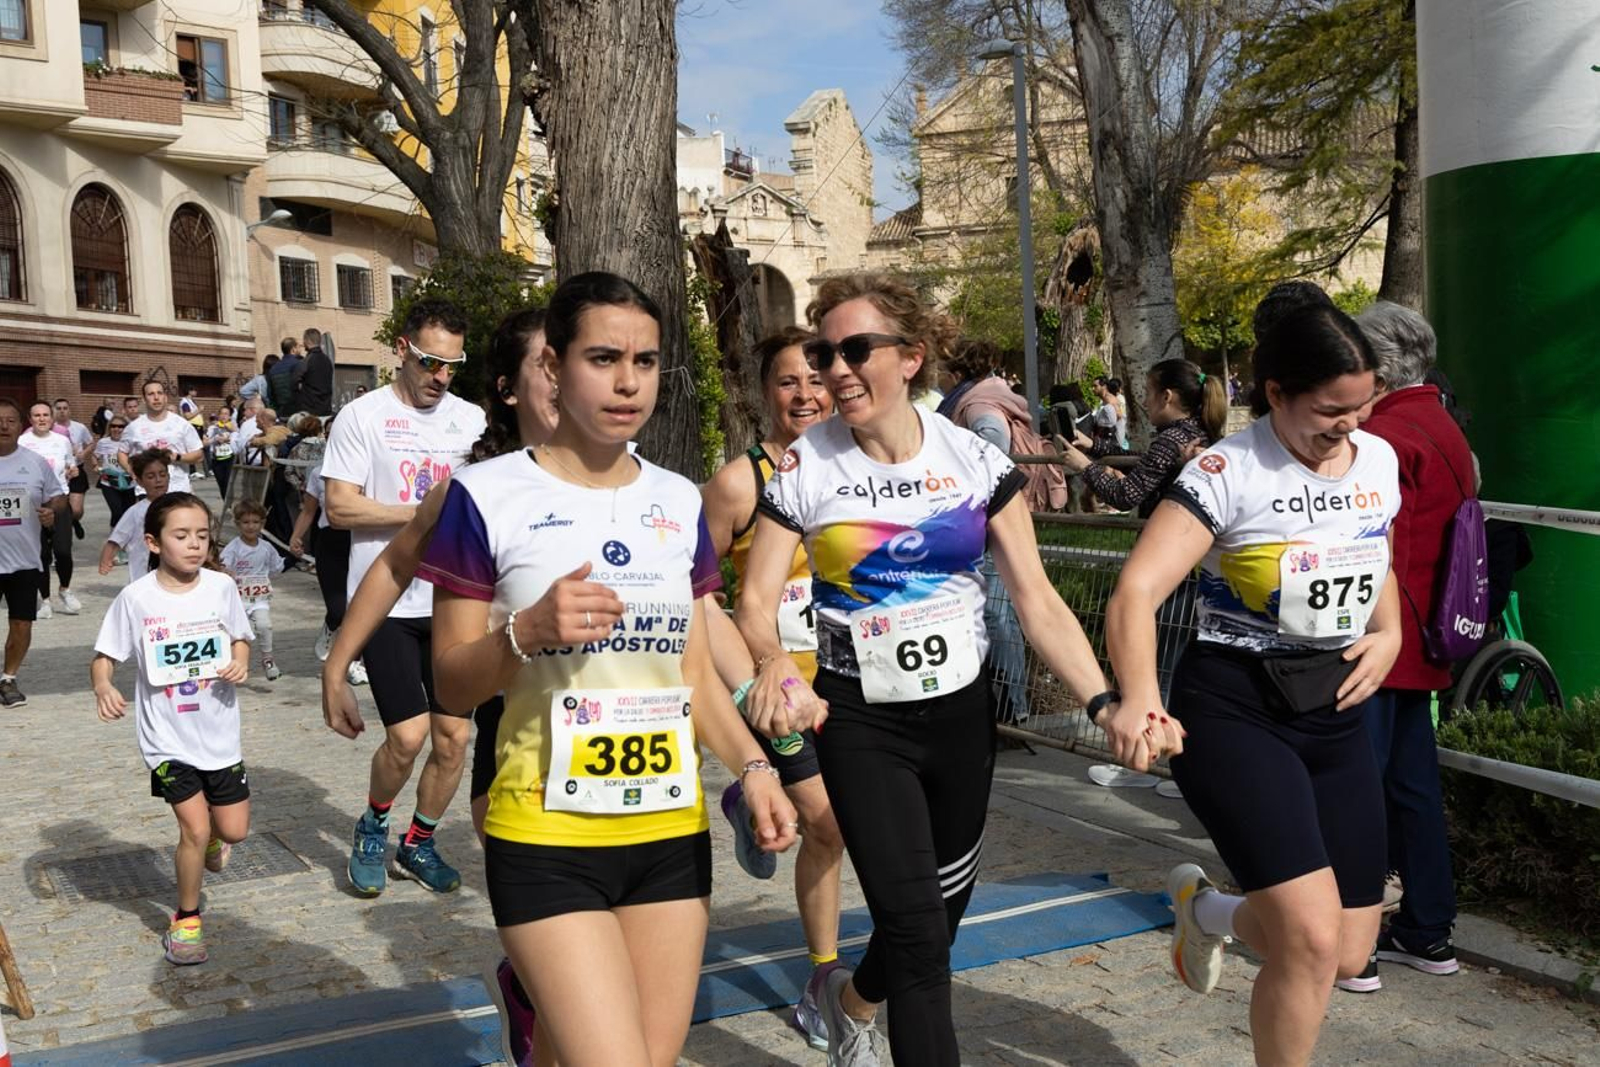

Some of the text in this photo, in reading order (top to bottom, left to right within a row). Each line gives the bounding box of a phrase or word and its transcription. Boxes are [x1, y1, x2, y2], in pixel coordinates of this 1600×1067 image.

[0, 497, 20, 509] 91
[613, 571, 666, 581] CARVAJAL
[1307, 573, 1374, 611] 875
[625, 601, 691, 617] RUNNING
[668, 617, 689, 633] DE
[164, 637, 217, 666] 524
[895, 633, 949, 673] 69
[584, 733, 672, 776] 385
